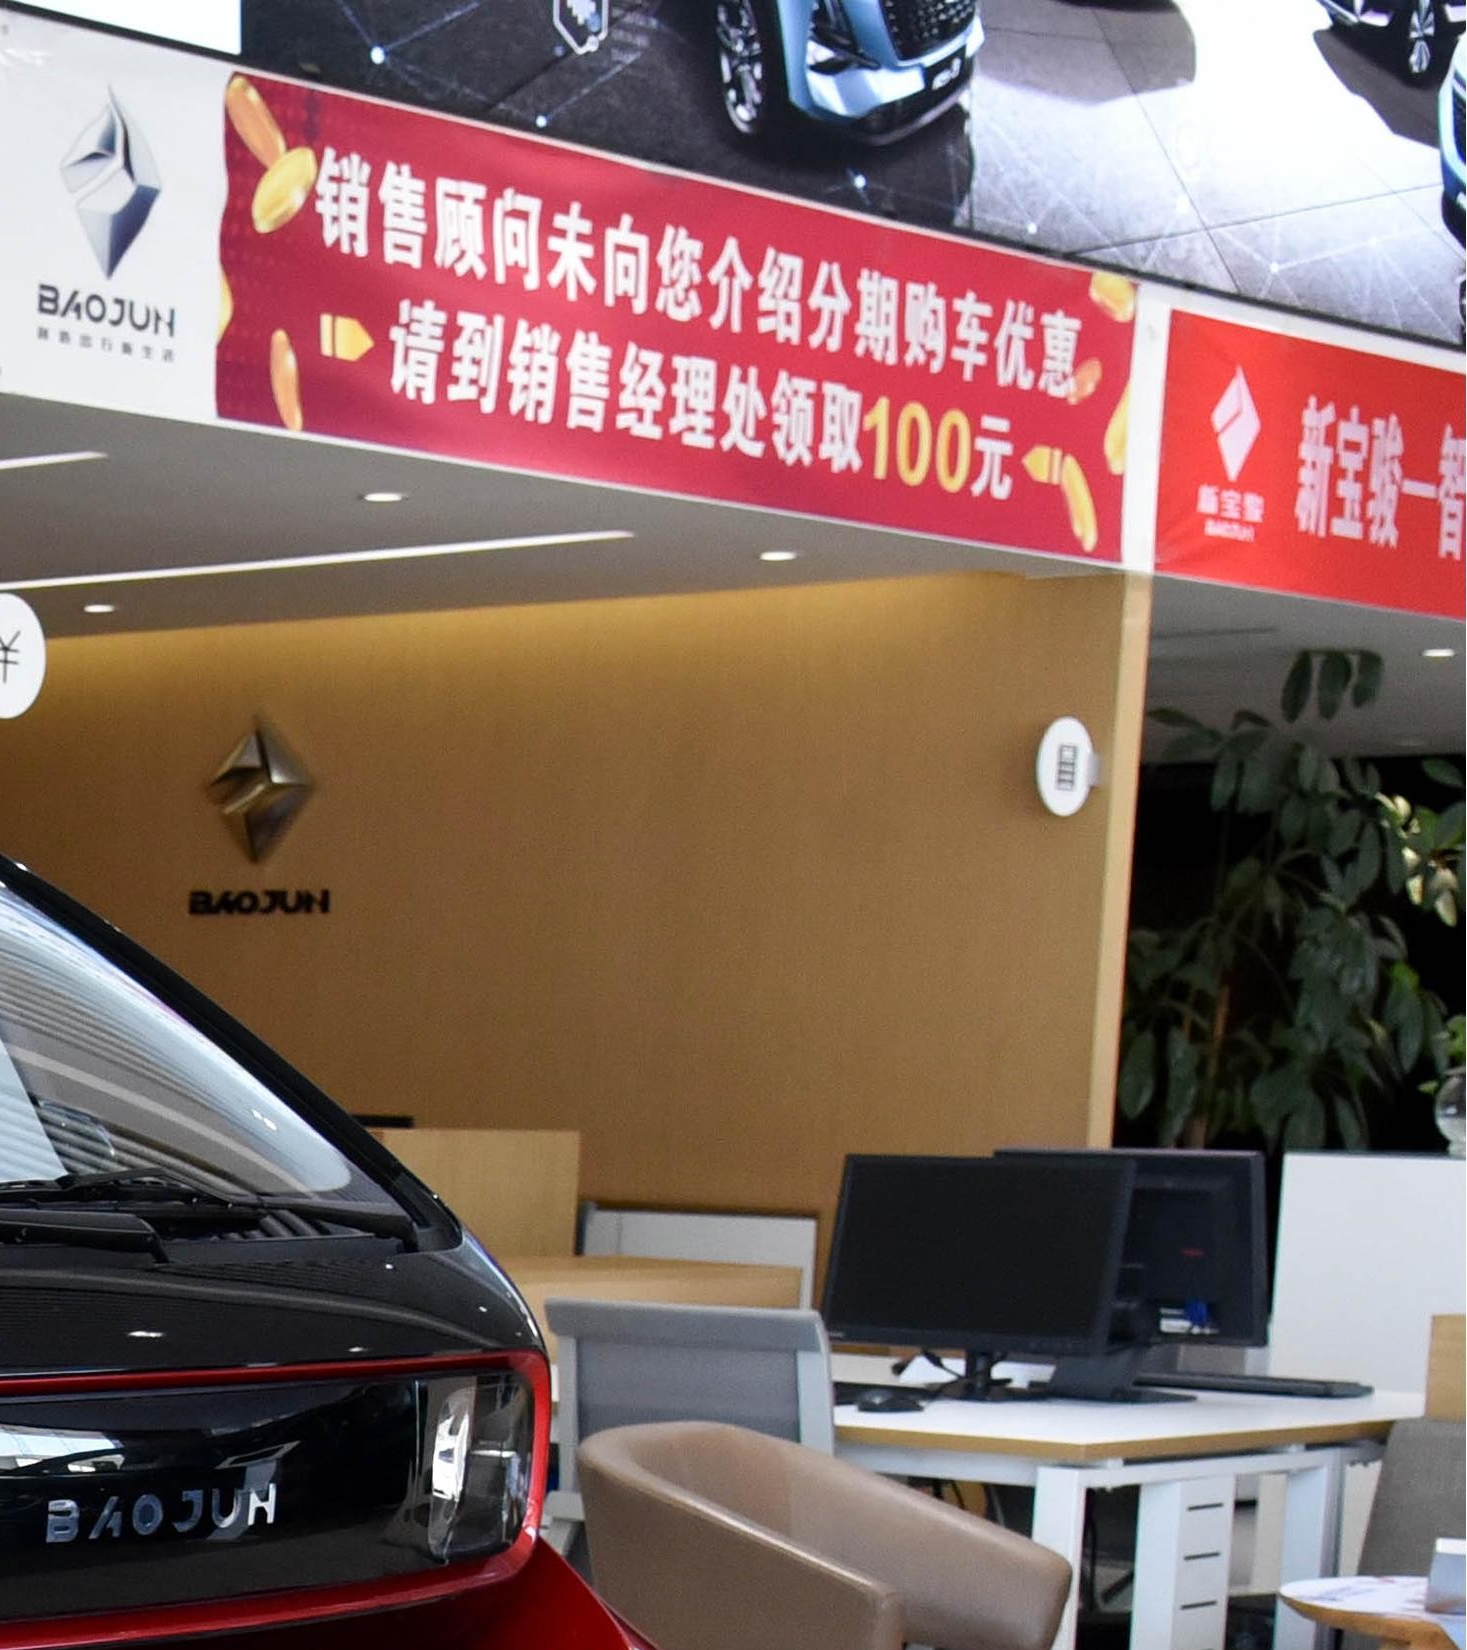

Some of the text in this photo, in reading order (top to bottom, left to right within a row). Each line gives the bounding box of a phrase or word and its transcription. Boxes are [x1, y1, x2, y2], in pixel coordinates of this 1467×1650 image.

[314, 146, 1082, 399] 销售顾问未向您介绍分期购车优惠
[37, 283, 175, 338] BAOJUN
[388, 299, 1014, 500] 请到销售经理处领取100元
[188, 889, 331, 915] BAOJUN
[45, 1482, 277, 1544] BAOJUN
